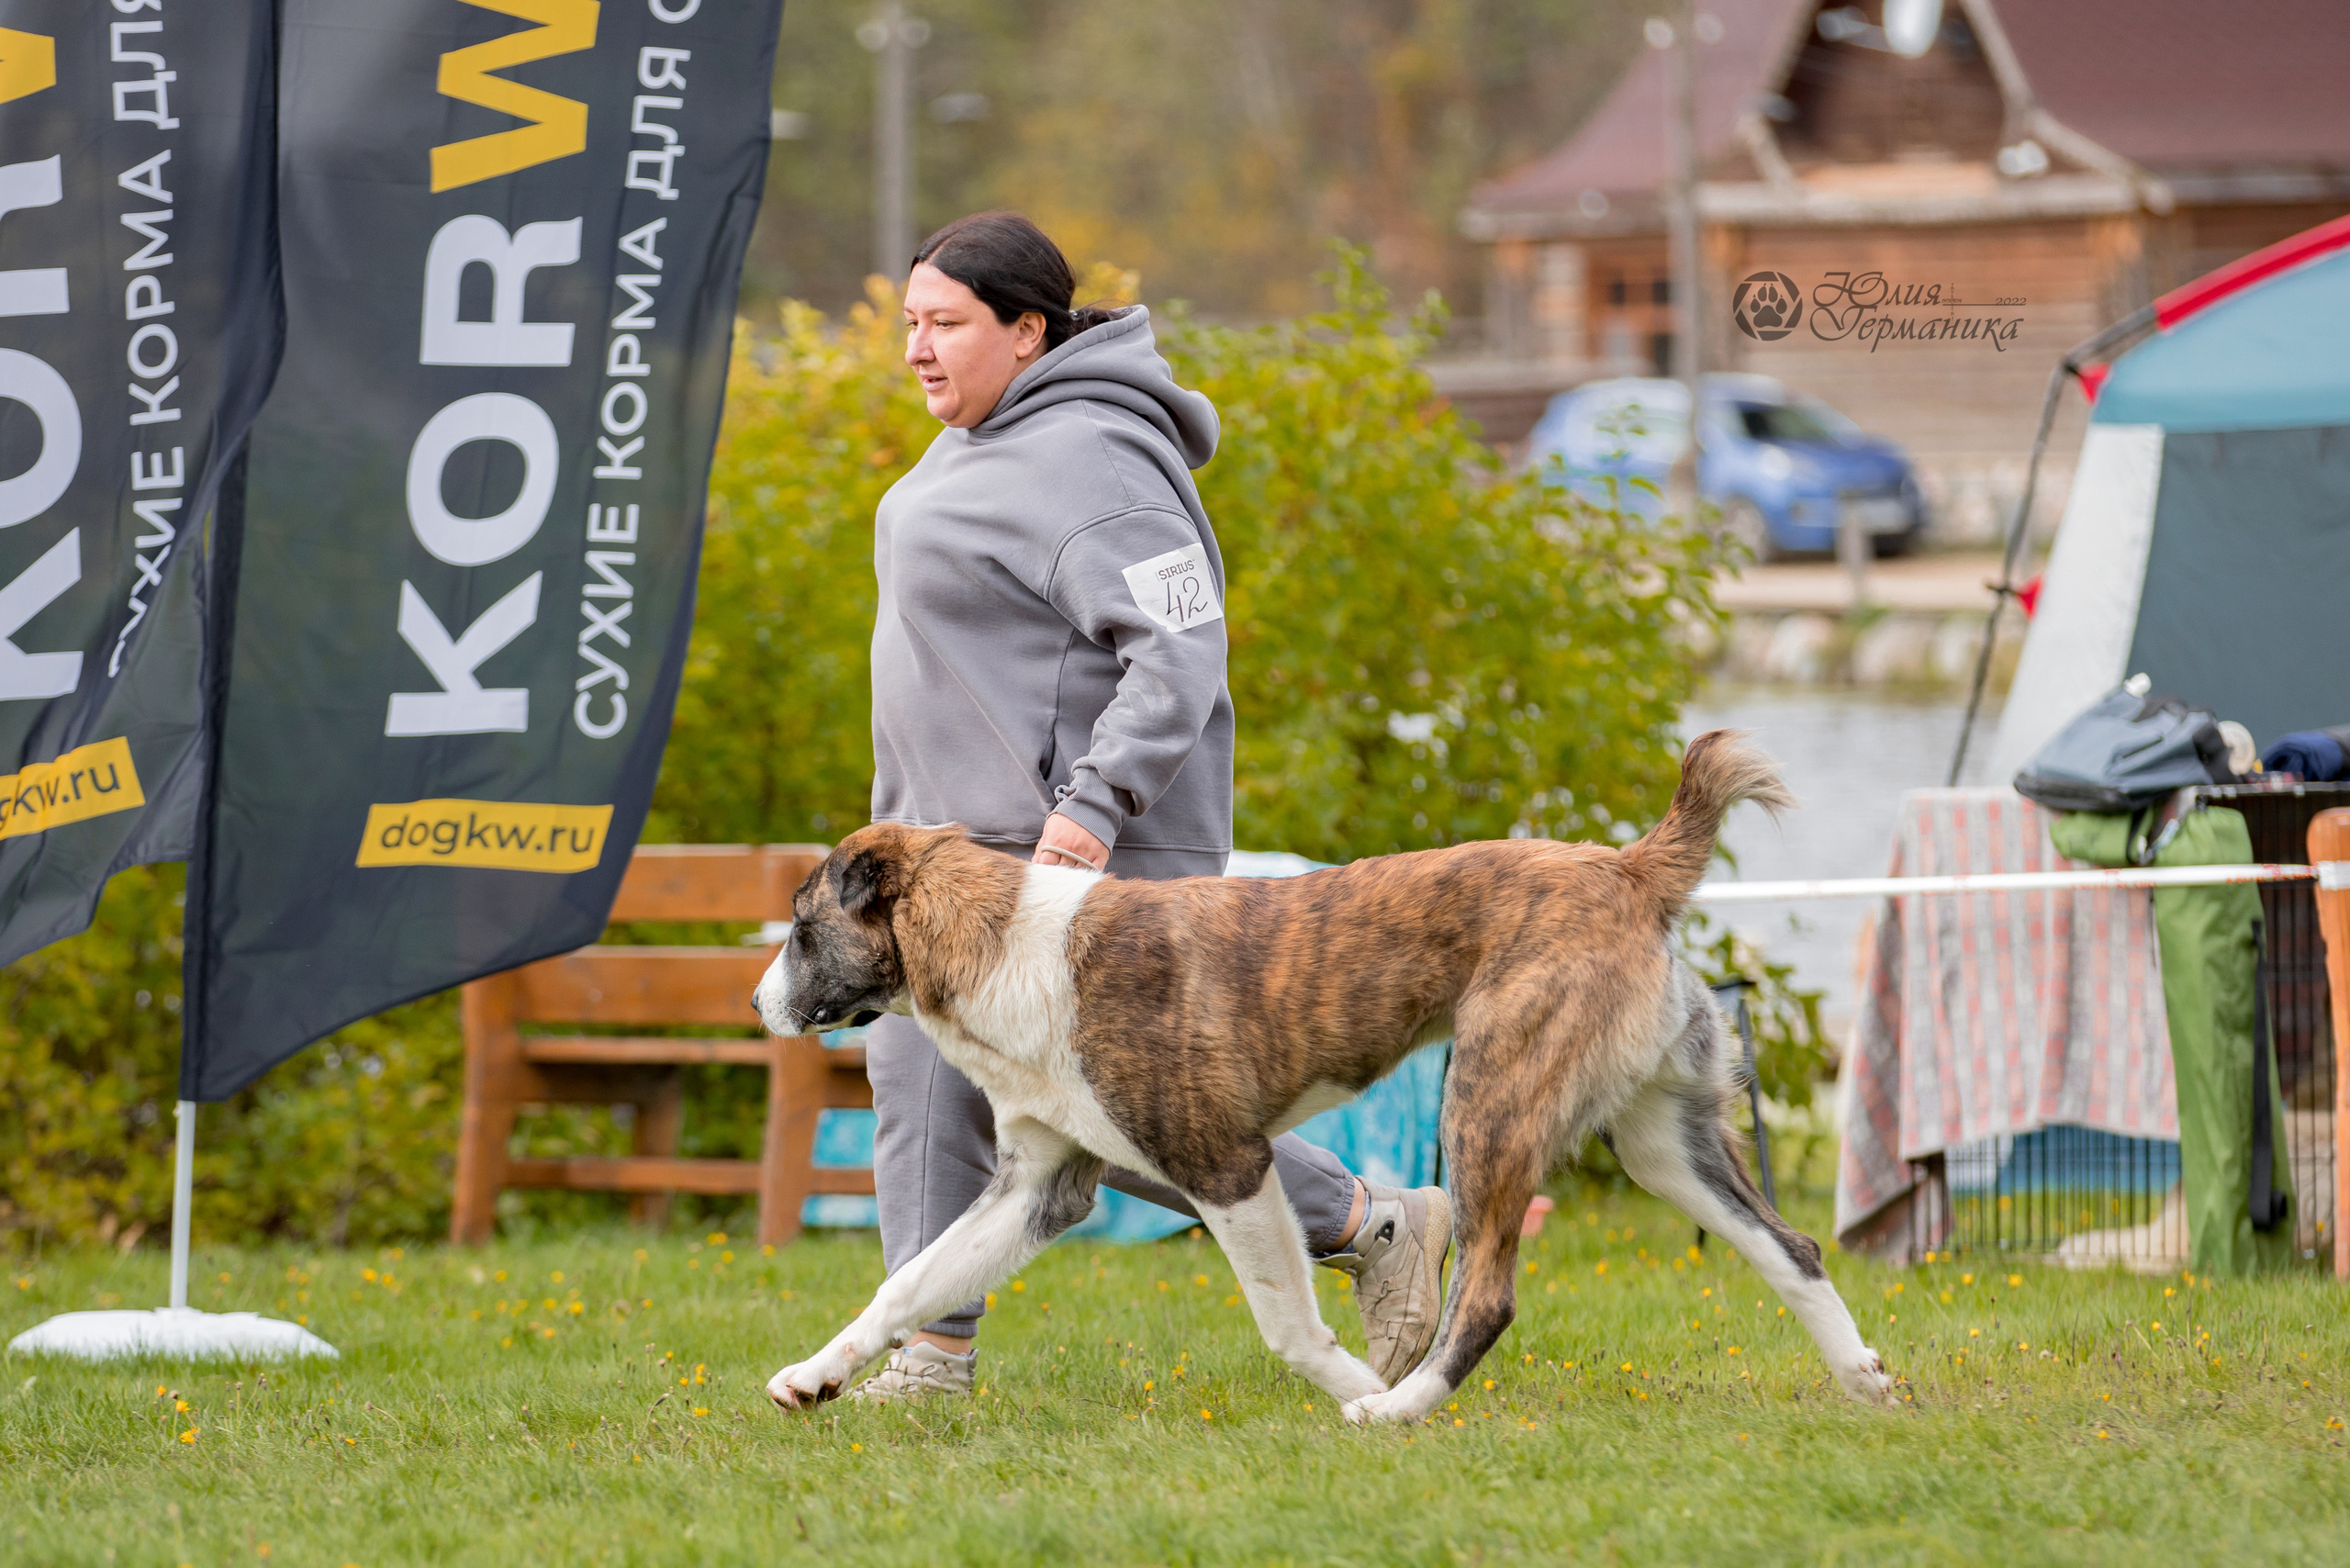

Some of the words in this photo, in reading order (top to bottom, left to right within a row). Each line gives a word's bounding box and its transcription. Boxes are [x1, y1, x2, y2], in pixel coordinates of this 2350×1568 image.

[109, 0, 180, 130] ДЛ
[624, 46, 692, 200] ДЛЯ
[118, 149, 182, 426] КОРМА
[592, 217, 667, 479] КОРМА
[574, 503, 640, 739] СУХИЕ
[1158, 559, 1195, 580] SIRIUS
[1166, 577, 1208, 622] 42
[380, 812, 595, 856] dogkw.ru
